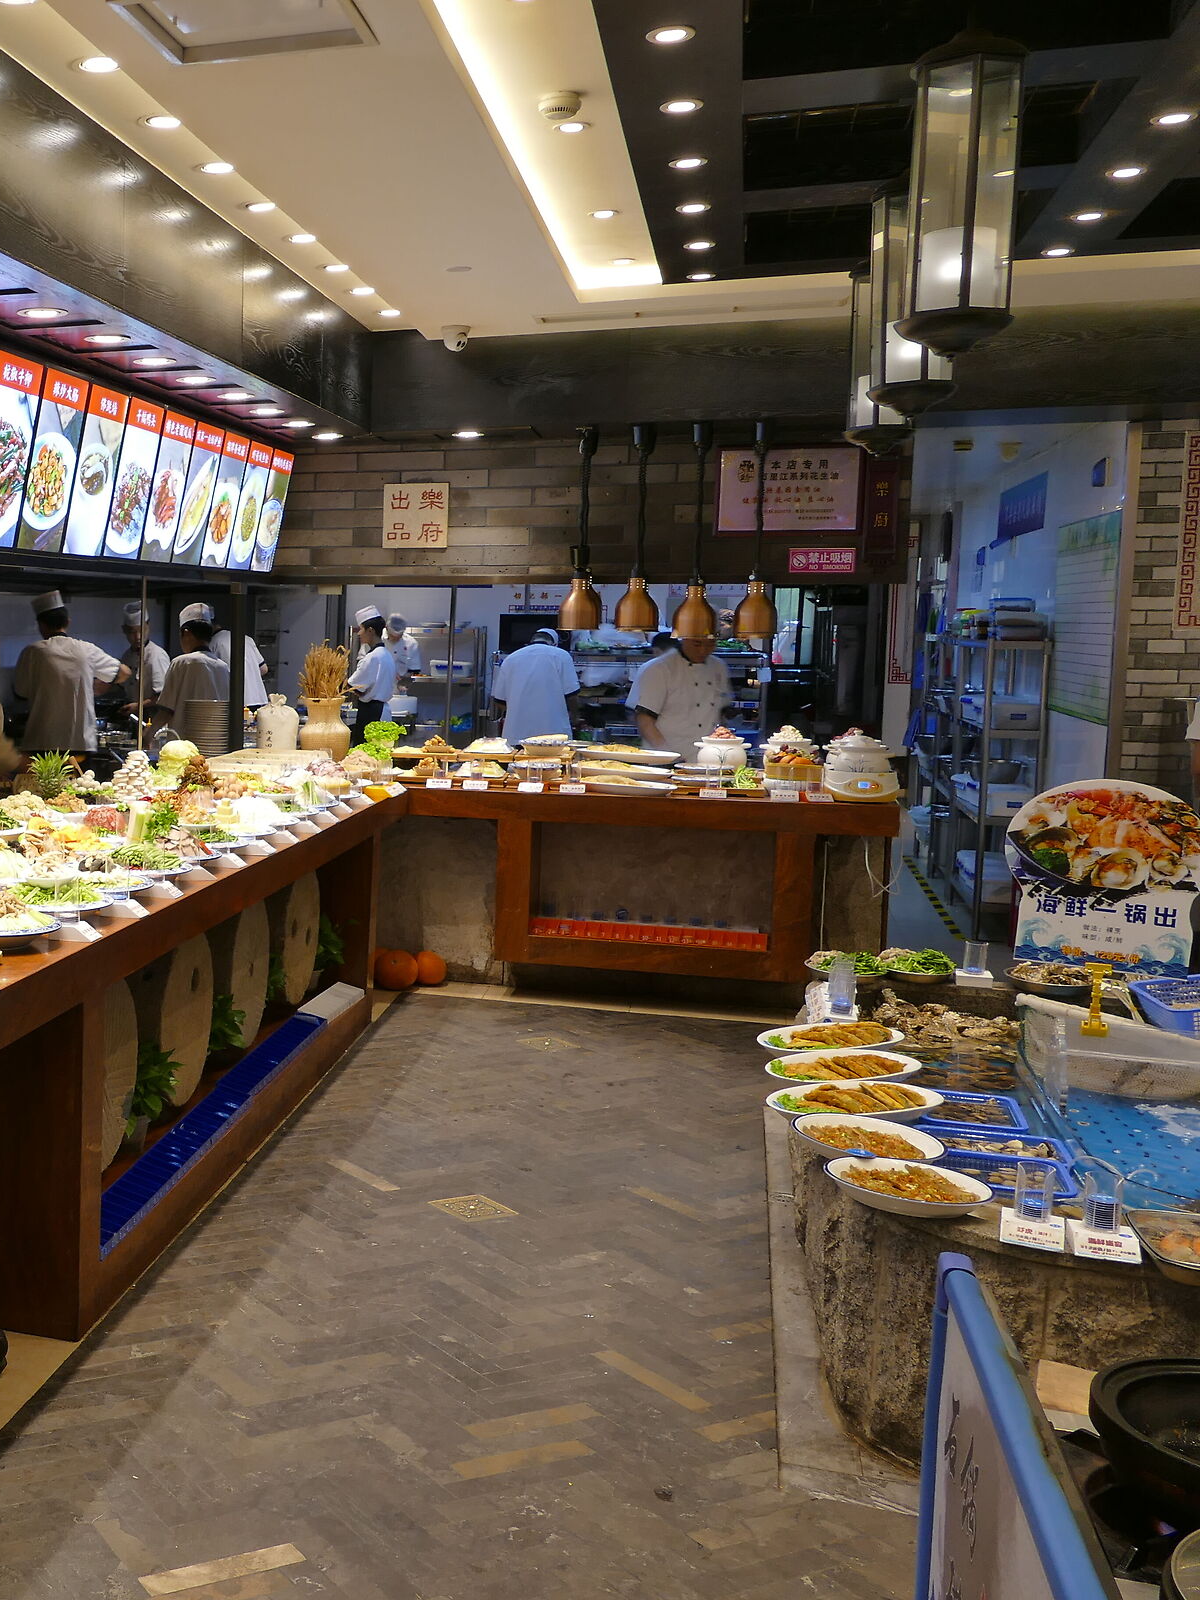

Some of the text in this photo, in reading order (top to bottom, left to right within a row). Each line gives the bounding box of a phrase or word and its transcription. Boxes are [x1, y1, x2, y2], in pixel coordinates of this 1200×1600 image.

[771, 459, 829, 470] 本店专用
[808, 552, 852, 563] 禁止吸烟
[1036, 895, 1178, 929] 海鲜一锅出
